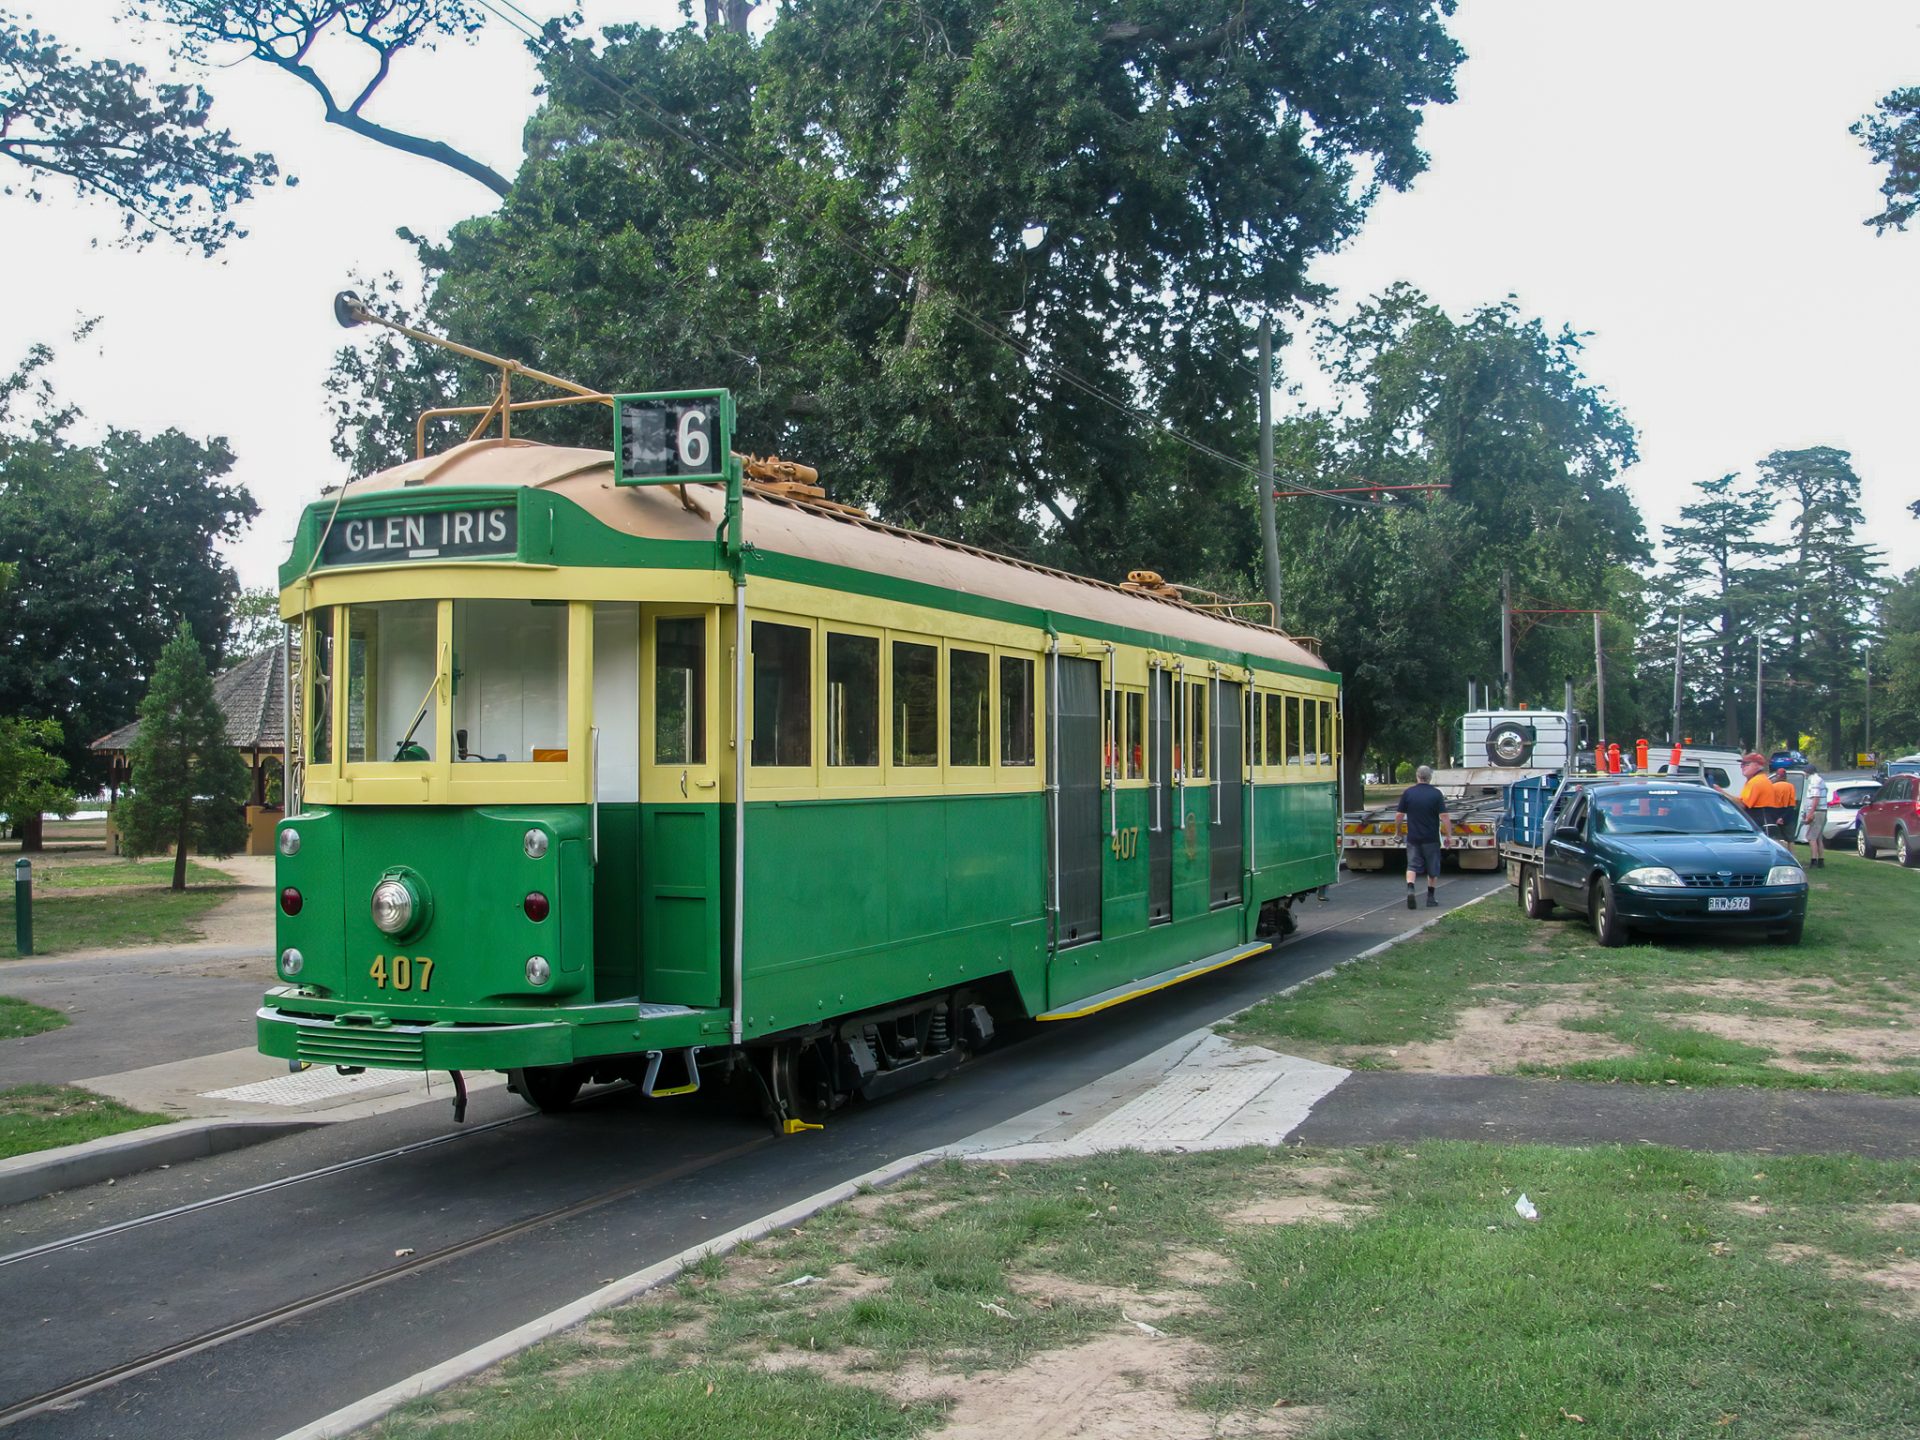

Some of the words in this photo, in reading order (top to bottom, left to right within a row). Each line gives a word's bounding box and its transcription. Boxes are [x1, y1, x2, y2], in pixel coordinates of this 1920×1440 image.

[678, 410, 710, 467] 6
[345, 514, 425, 552] GLEN
[442, 509, 507, 545] IRIS
[1111, 826, 1138, 861] 407
[369, 954, 435, 992] 407
